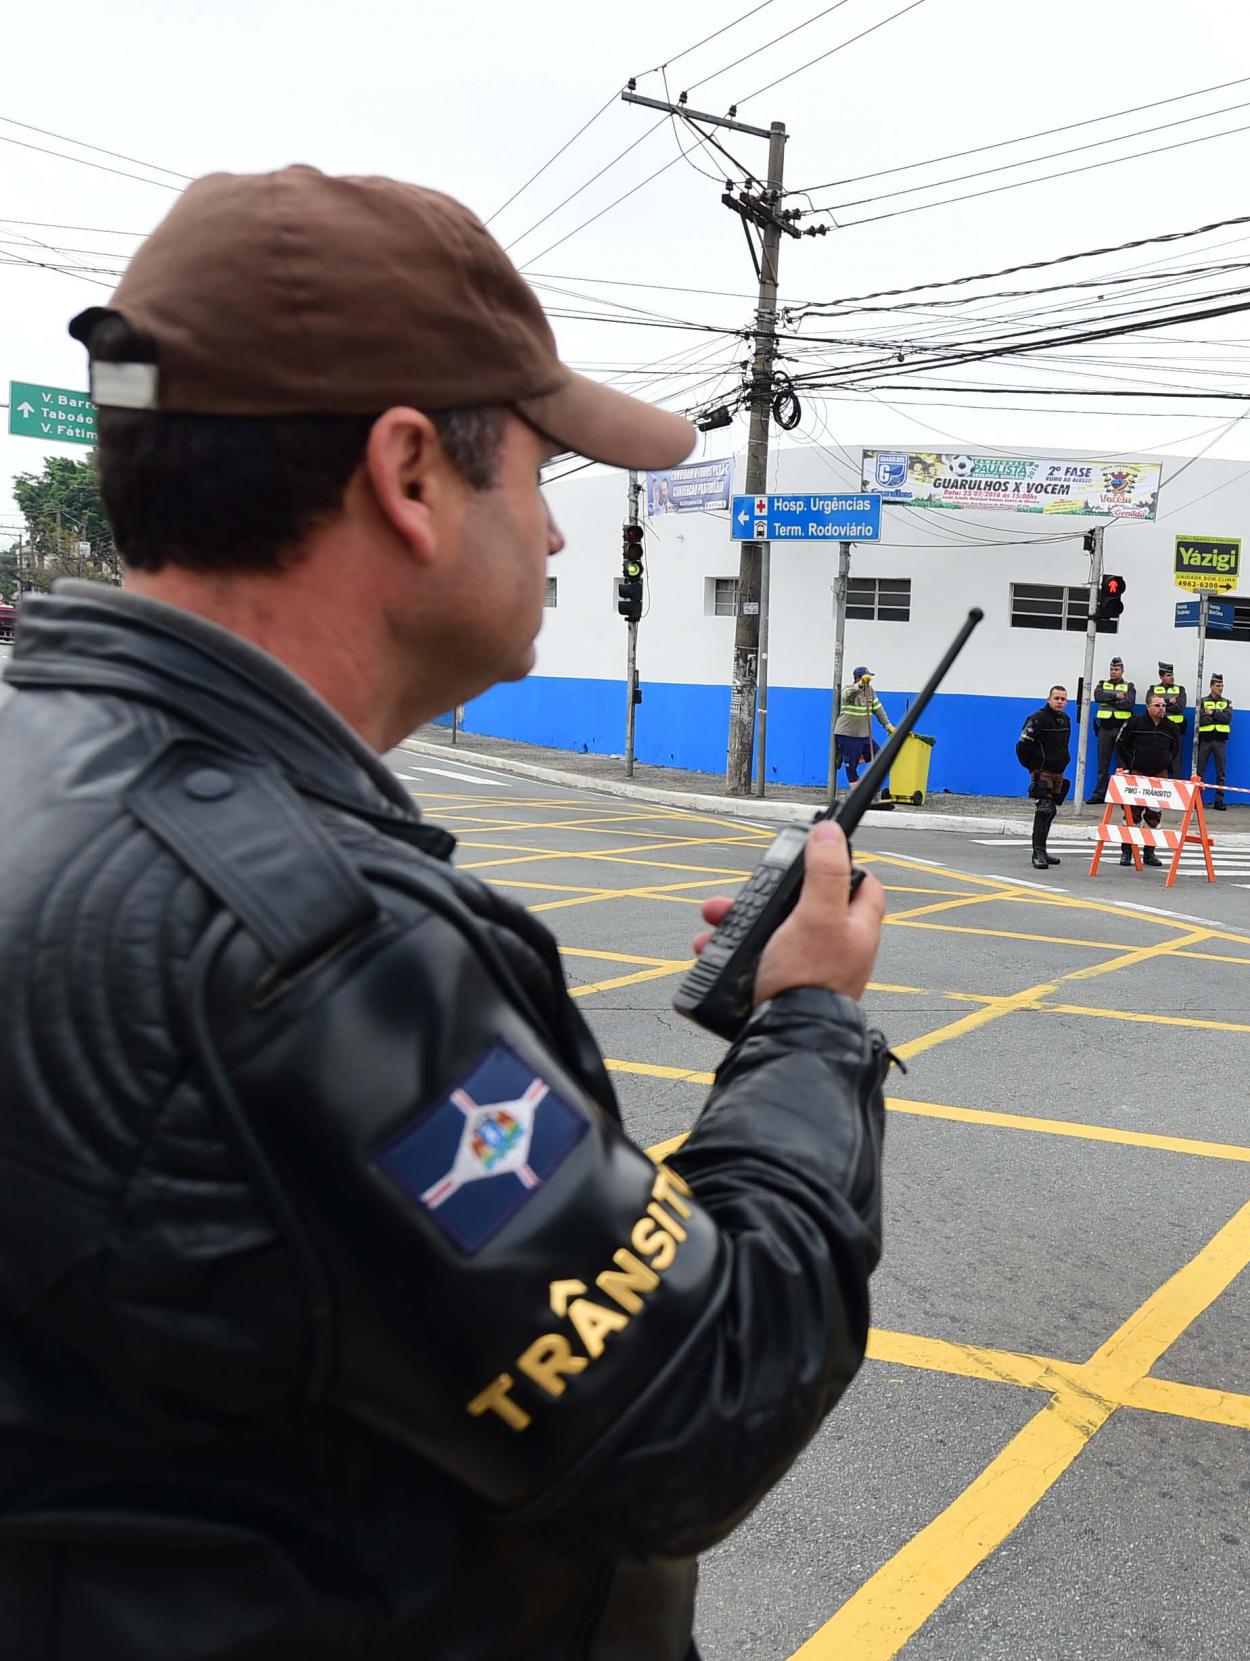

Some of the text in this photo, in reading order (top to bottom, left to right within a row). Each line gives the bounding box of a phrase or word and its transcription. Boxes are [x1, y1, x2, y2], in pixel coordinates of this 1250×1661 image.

[42, 392, 54, 404] V.
[41, 422, 53, 434] V.
[973, 464, 1027, 475] PAULISTA
[1064, 467, 1093, 478] FASE
[933, 478, 1010, 492] GUARULHOS
[1026, 482, 1071, 495] VOCEM
[774, 497, 871, 514] Hosp. Urgências
[774, 522, 873, 537] Term. Rodoviário
[1178, 547, 1236, 571] Yázigi
[1178, 581, 1218, 589] 4962-6200
[1142, 788, 1172, 798] TRÂNSITO
